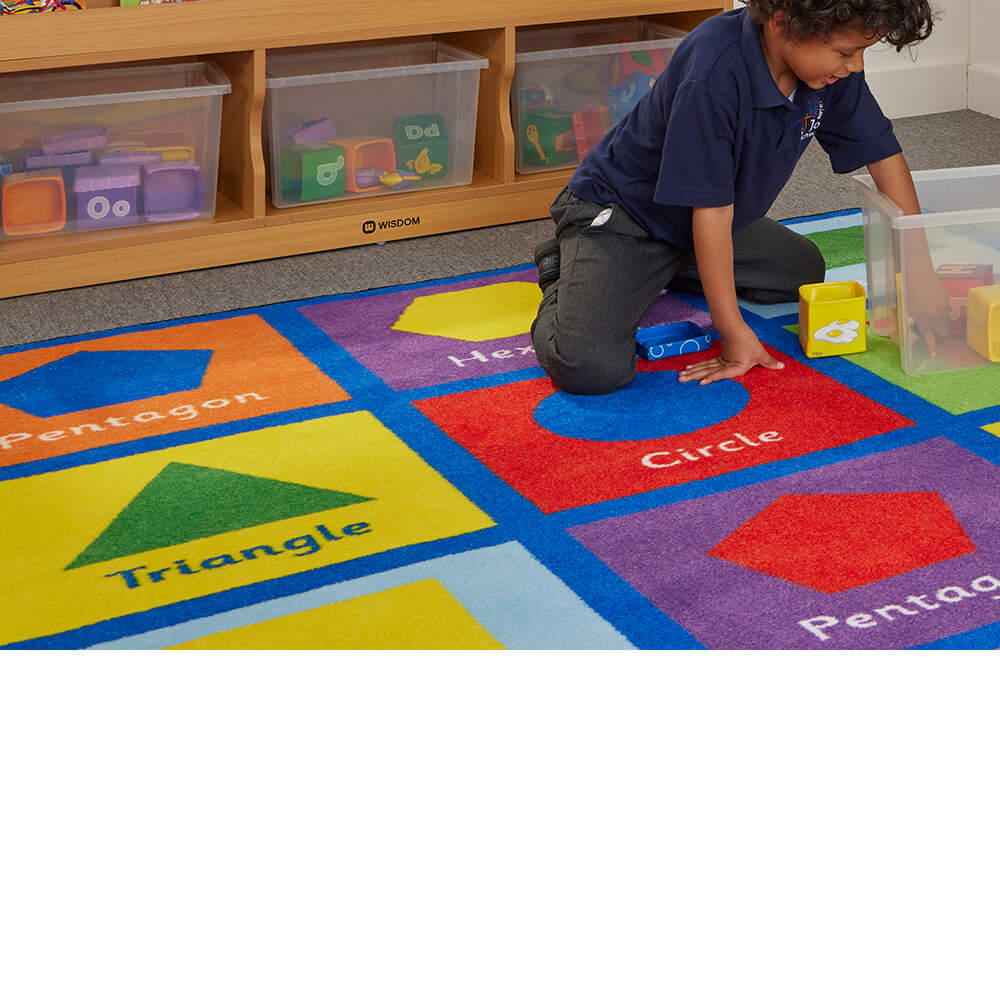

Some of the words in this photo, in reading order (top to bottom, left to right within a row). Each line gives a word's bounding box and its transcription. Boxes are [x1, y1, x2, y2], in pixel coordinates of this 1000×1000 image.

[404, 123, 440, 140] Dd
[87, 196, 131, 219] Oo
[378, 216, 420, 230] WISDOM
[0, 390, 270, 451] Pentagon
[641, 426, 784, 469] Circle
[105, 517, 373, 589] Triangle
